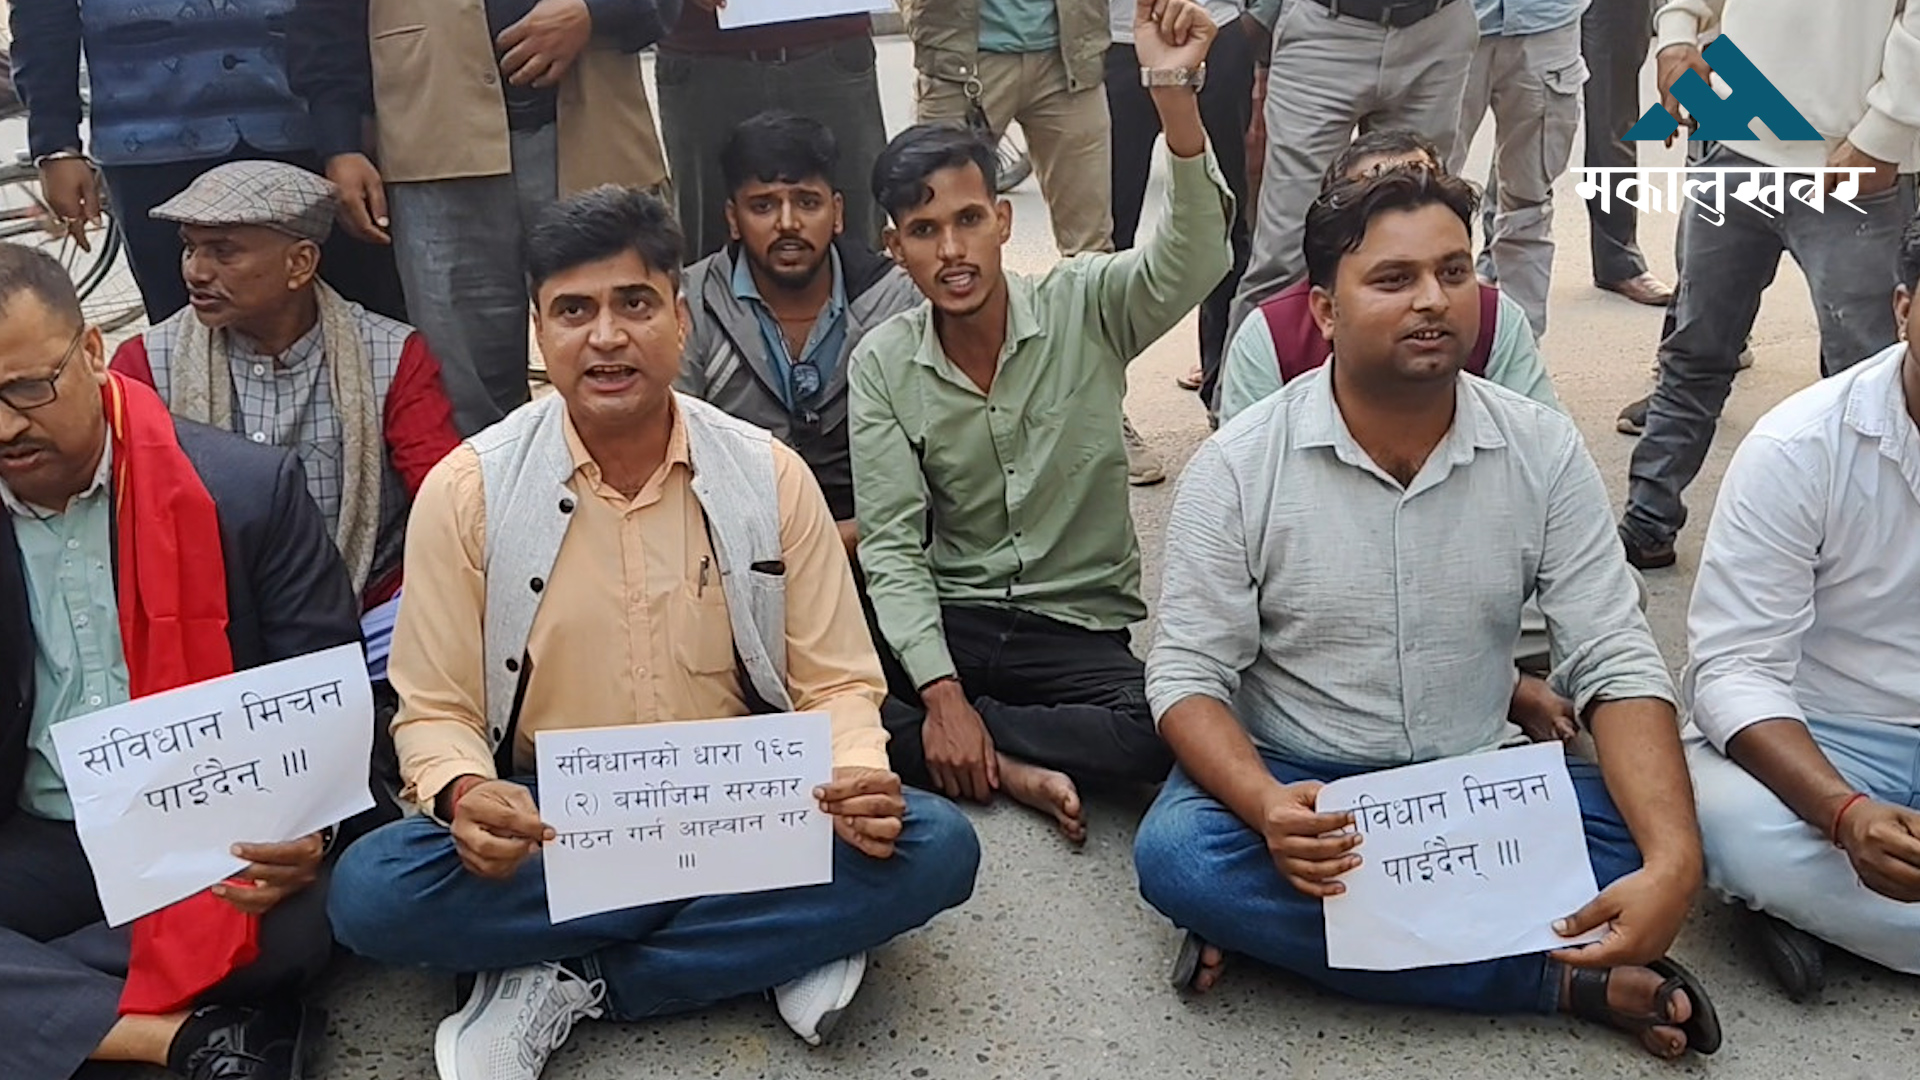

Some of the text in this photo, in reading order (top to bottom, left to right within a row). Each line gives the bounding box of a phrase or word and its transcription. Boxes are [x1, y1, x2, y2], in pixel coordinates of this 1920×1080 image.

[78, 679, 343, 775] संविधान मिचन
[555, 738, 805, 777] संविधानको धारा १६८
[144, 757, 272, 813] पाईदैन्
[564, 791, 600, 817] (२)
[723, 777, 803, 802] सरकार
[1462, 774, 1551, 815] मिचन
[556, 828, 614, 850] गठन
[626, 817, 665, 842] गर्न
[778, 808, 811, 827] गर
[1381, 835, 1489, 885] पाईदैन्
